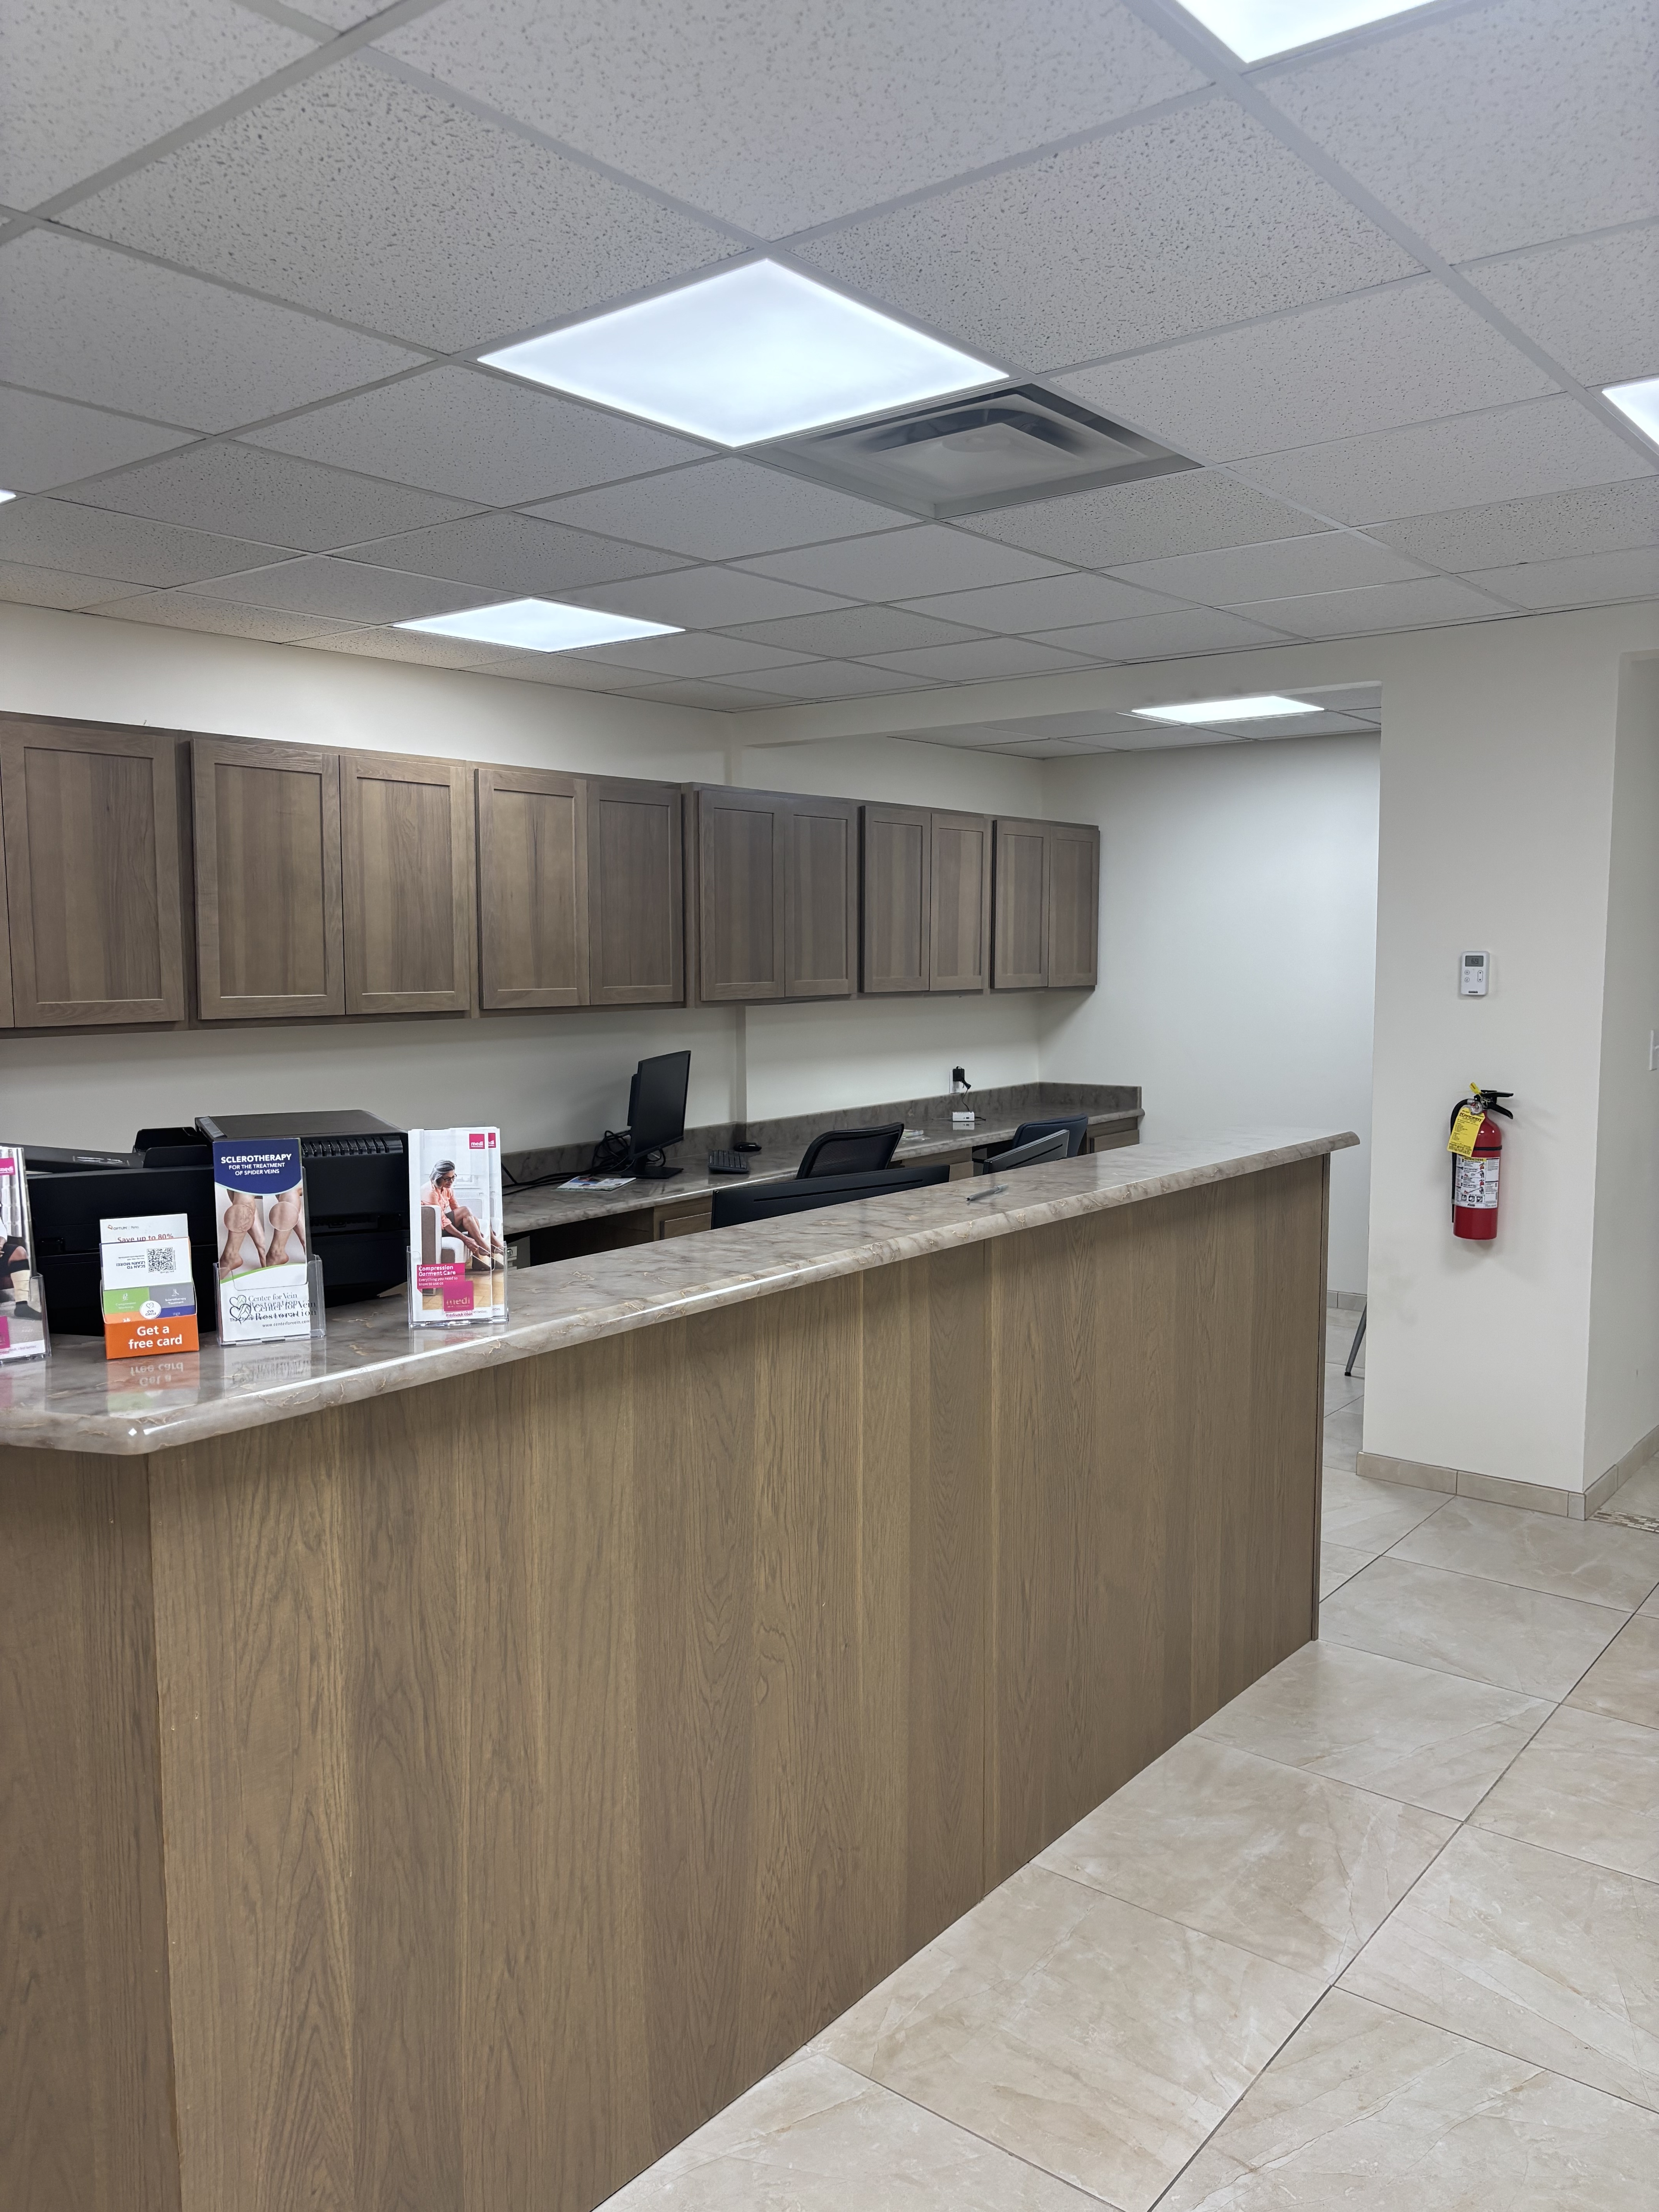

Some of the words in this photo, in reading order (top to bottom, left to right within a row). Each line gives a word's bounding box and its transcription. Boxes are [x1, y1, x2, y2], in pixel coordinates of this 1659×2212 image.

[221, 1154, 292, 1164] SCLEROTHERAPY
[446, 1297, 470, 1305] medi
[137, 1326, 159, 1336] Get
[129, 1339, 153, 1349] free
[157, 1334, 182, 1346] card
